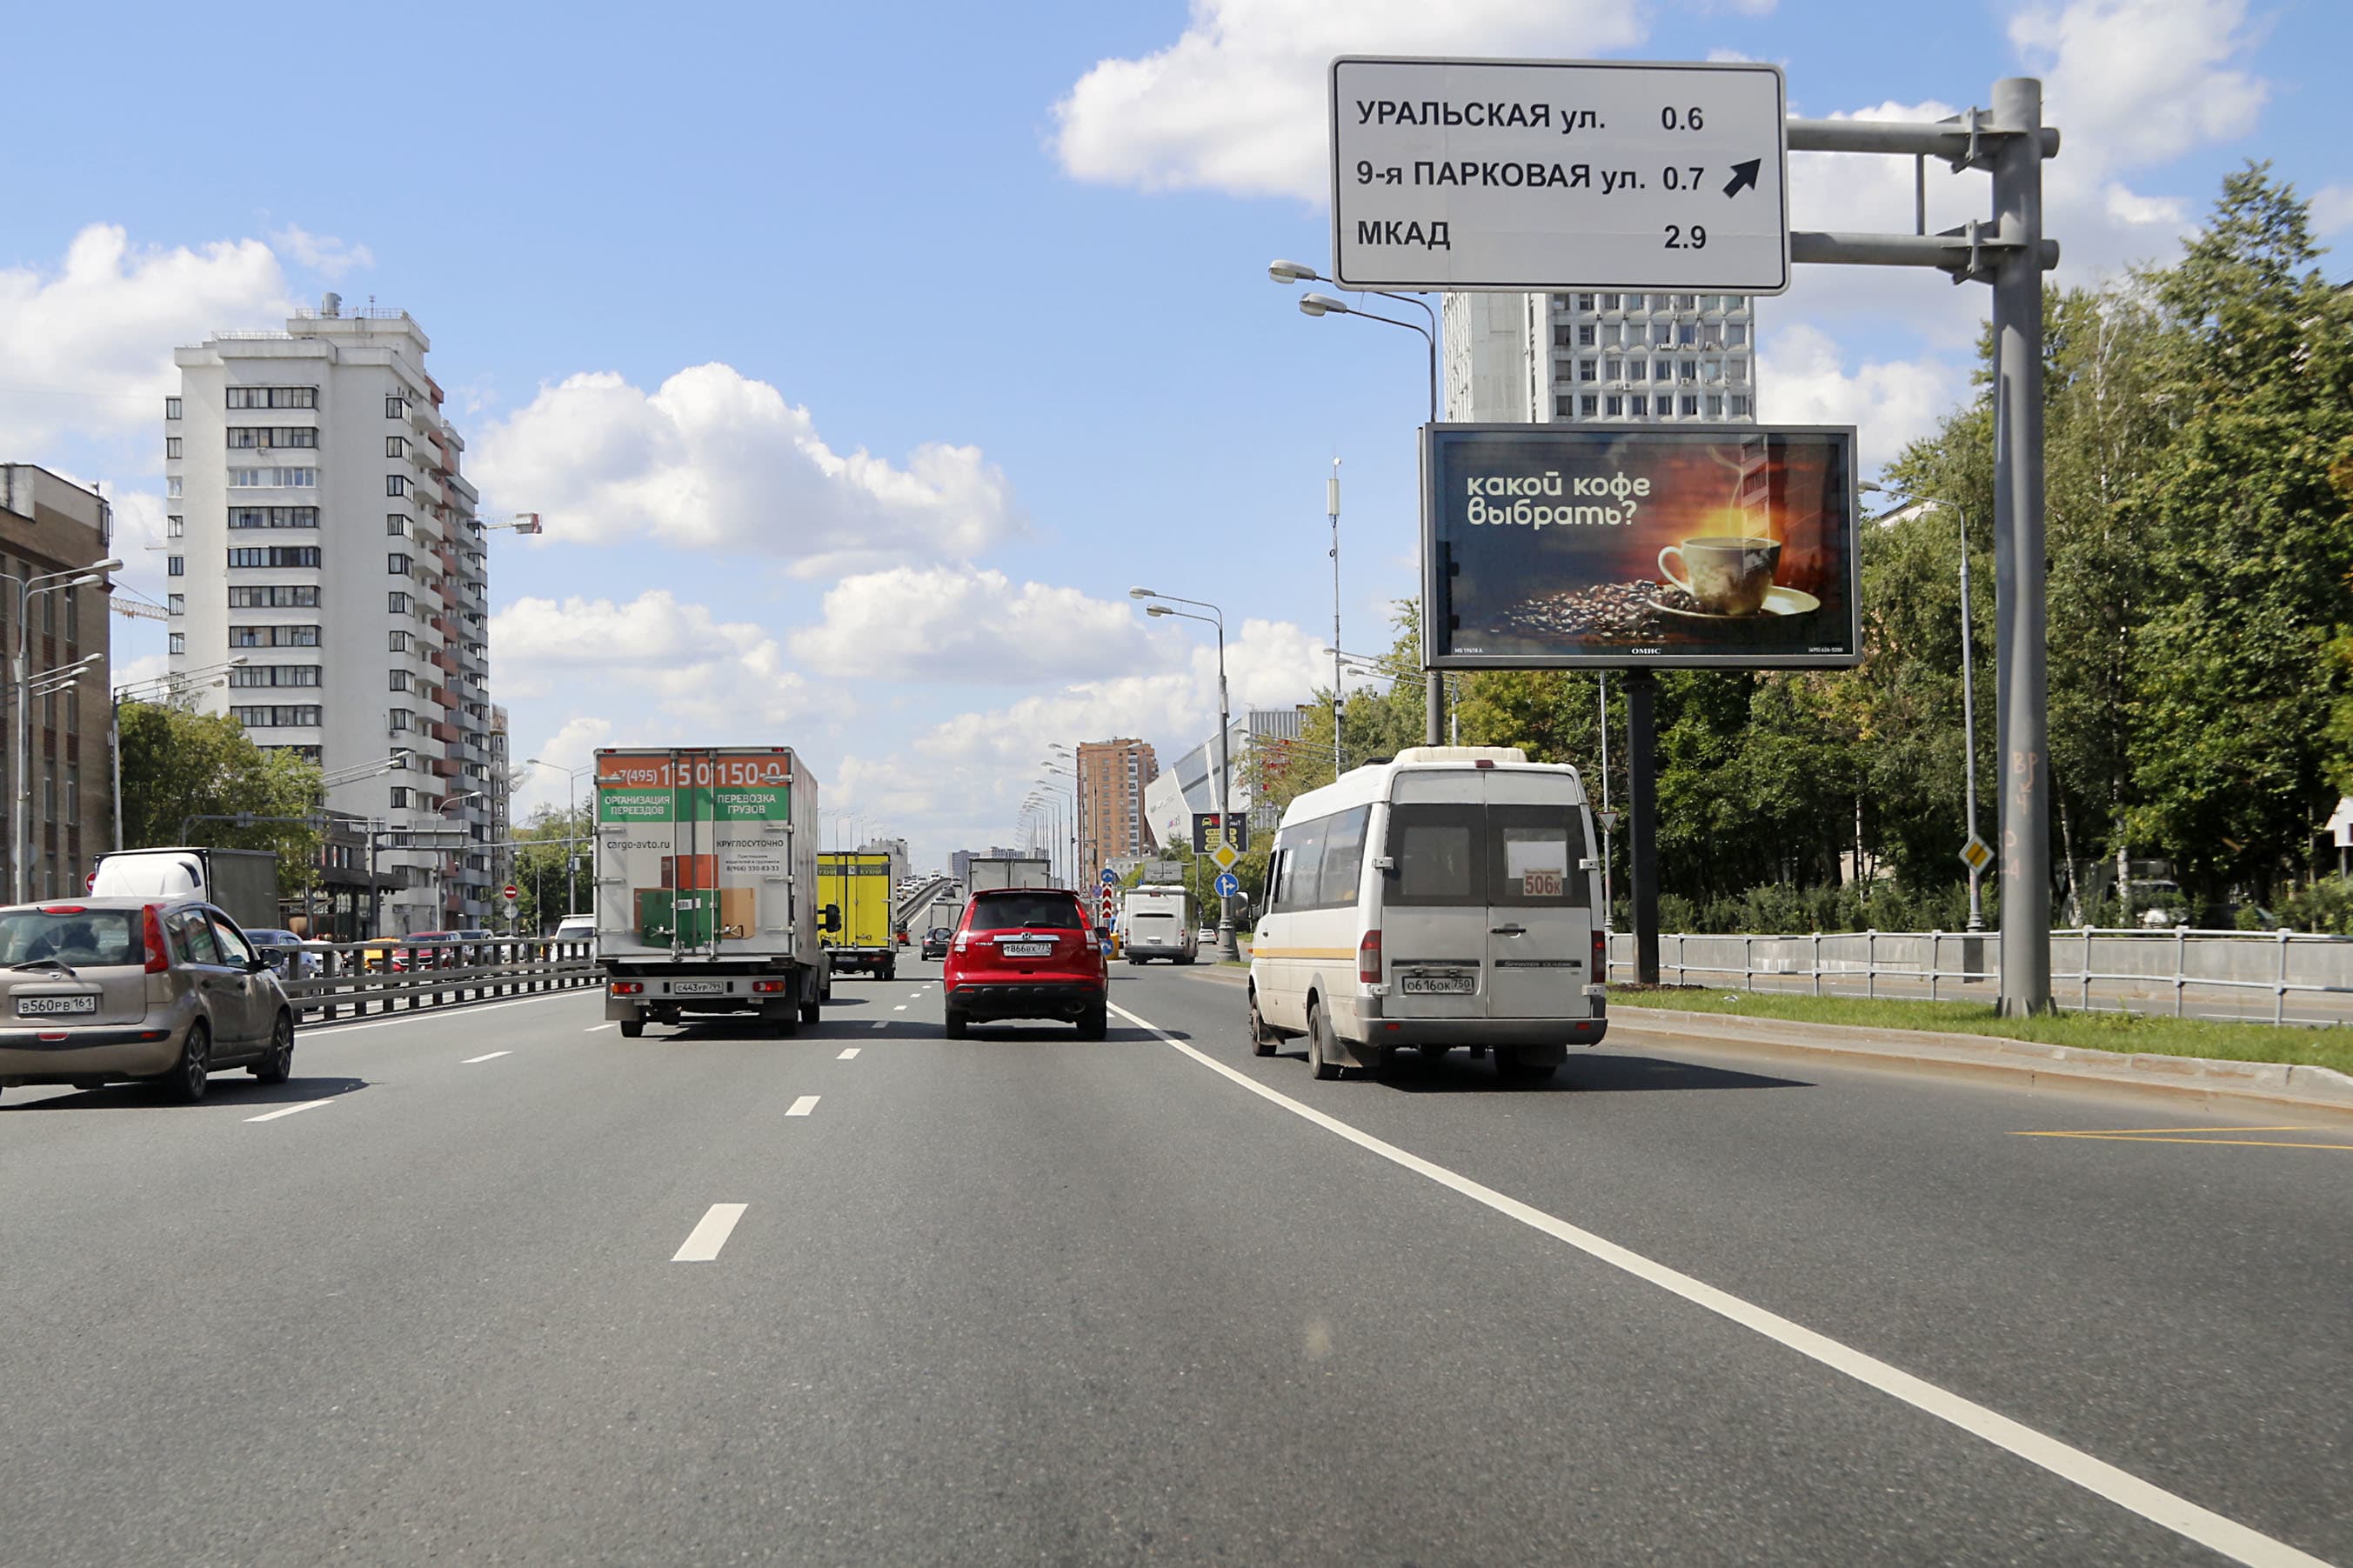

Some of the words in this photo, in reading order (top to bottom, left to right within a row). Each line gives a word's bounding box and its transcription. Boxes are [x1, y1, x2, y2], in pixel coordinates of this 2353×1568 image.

[1357, 101, 1549, 127] УРАЛЬСКАЯ
[1561, 110, 1605, 134] ул.
[1662, 107, 1703, 130] 0.6
[1357, 161, 1401, 184] 9-я
[1415, 162, 1589, 188] ПАРКОВАЯ
[1601, 171, 1645, 195] ул.
[1663, 167, 1704, 190] 0.7
[1359, 221, 1450, 250] МКАД
[1665, 225, 1706, 249] 2.9
[1467, 470, 1562, 497] какой
[1574, 470, 1651, 502] кофе
[1467, 497, 1637, 530] выбрать?
[605, 796, 671, 805] ОРГАНИЗАЦИЯ
[717, 793, 777, 804] ПЕРЕВОЗКА
[611, 806, 665, 815] ПЕРЕЕЗДОВ
[727, 805, 766, 815] ГРУЗОВ
[606, 840, 671, 851] cargo-avto.ru
[716, 839, 785, 848] КРУГЛОСУТОЧНО
[22, 999, 70, 1012] В560РВ
